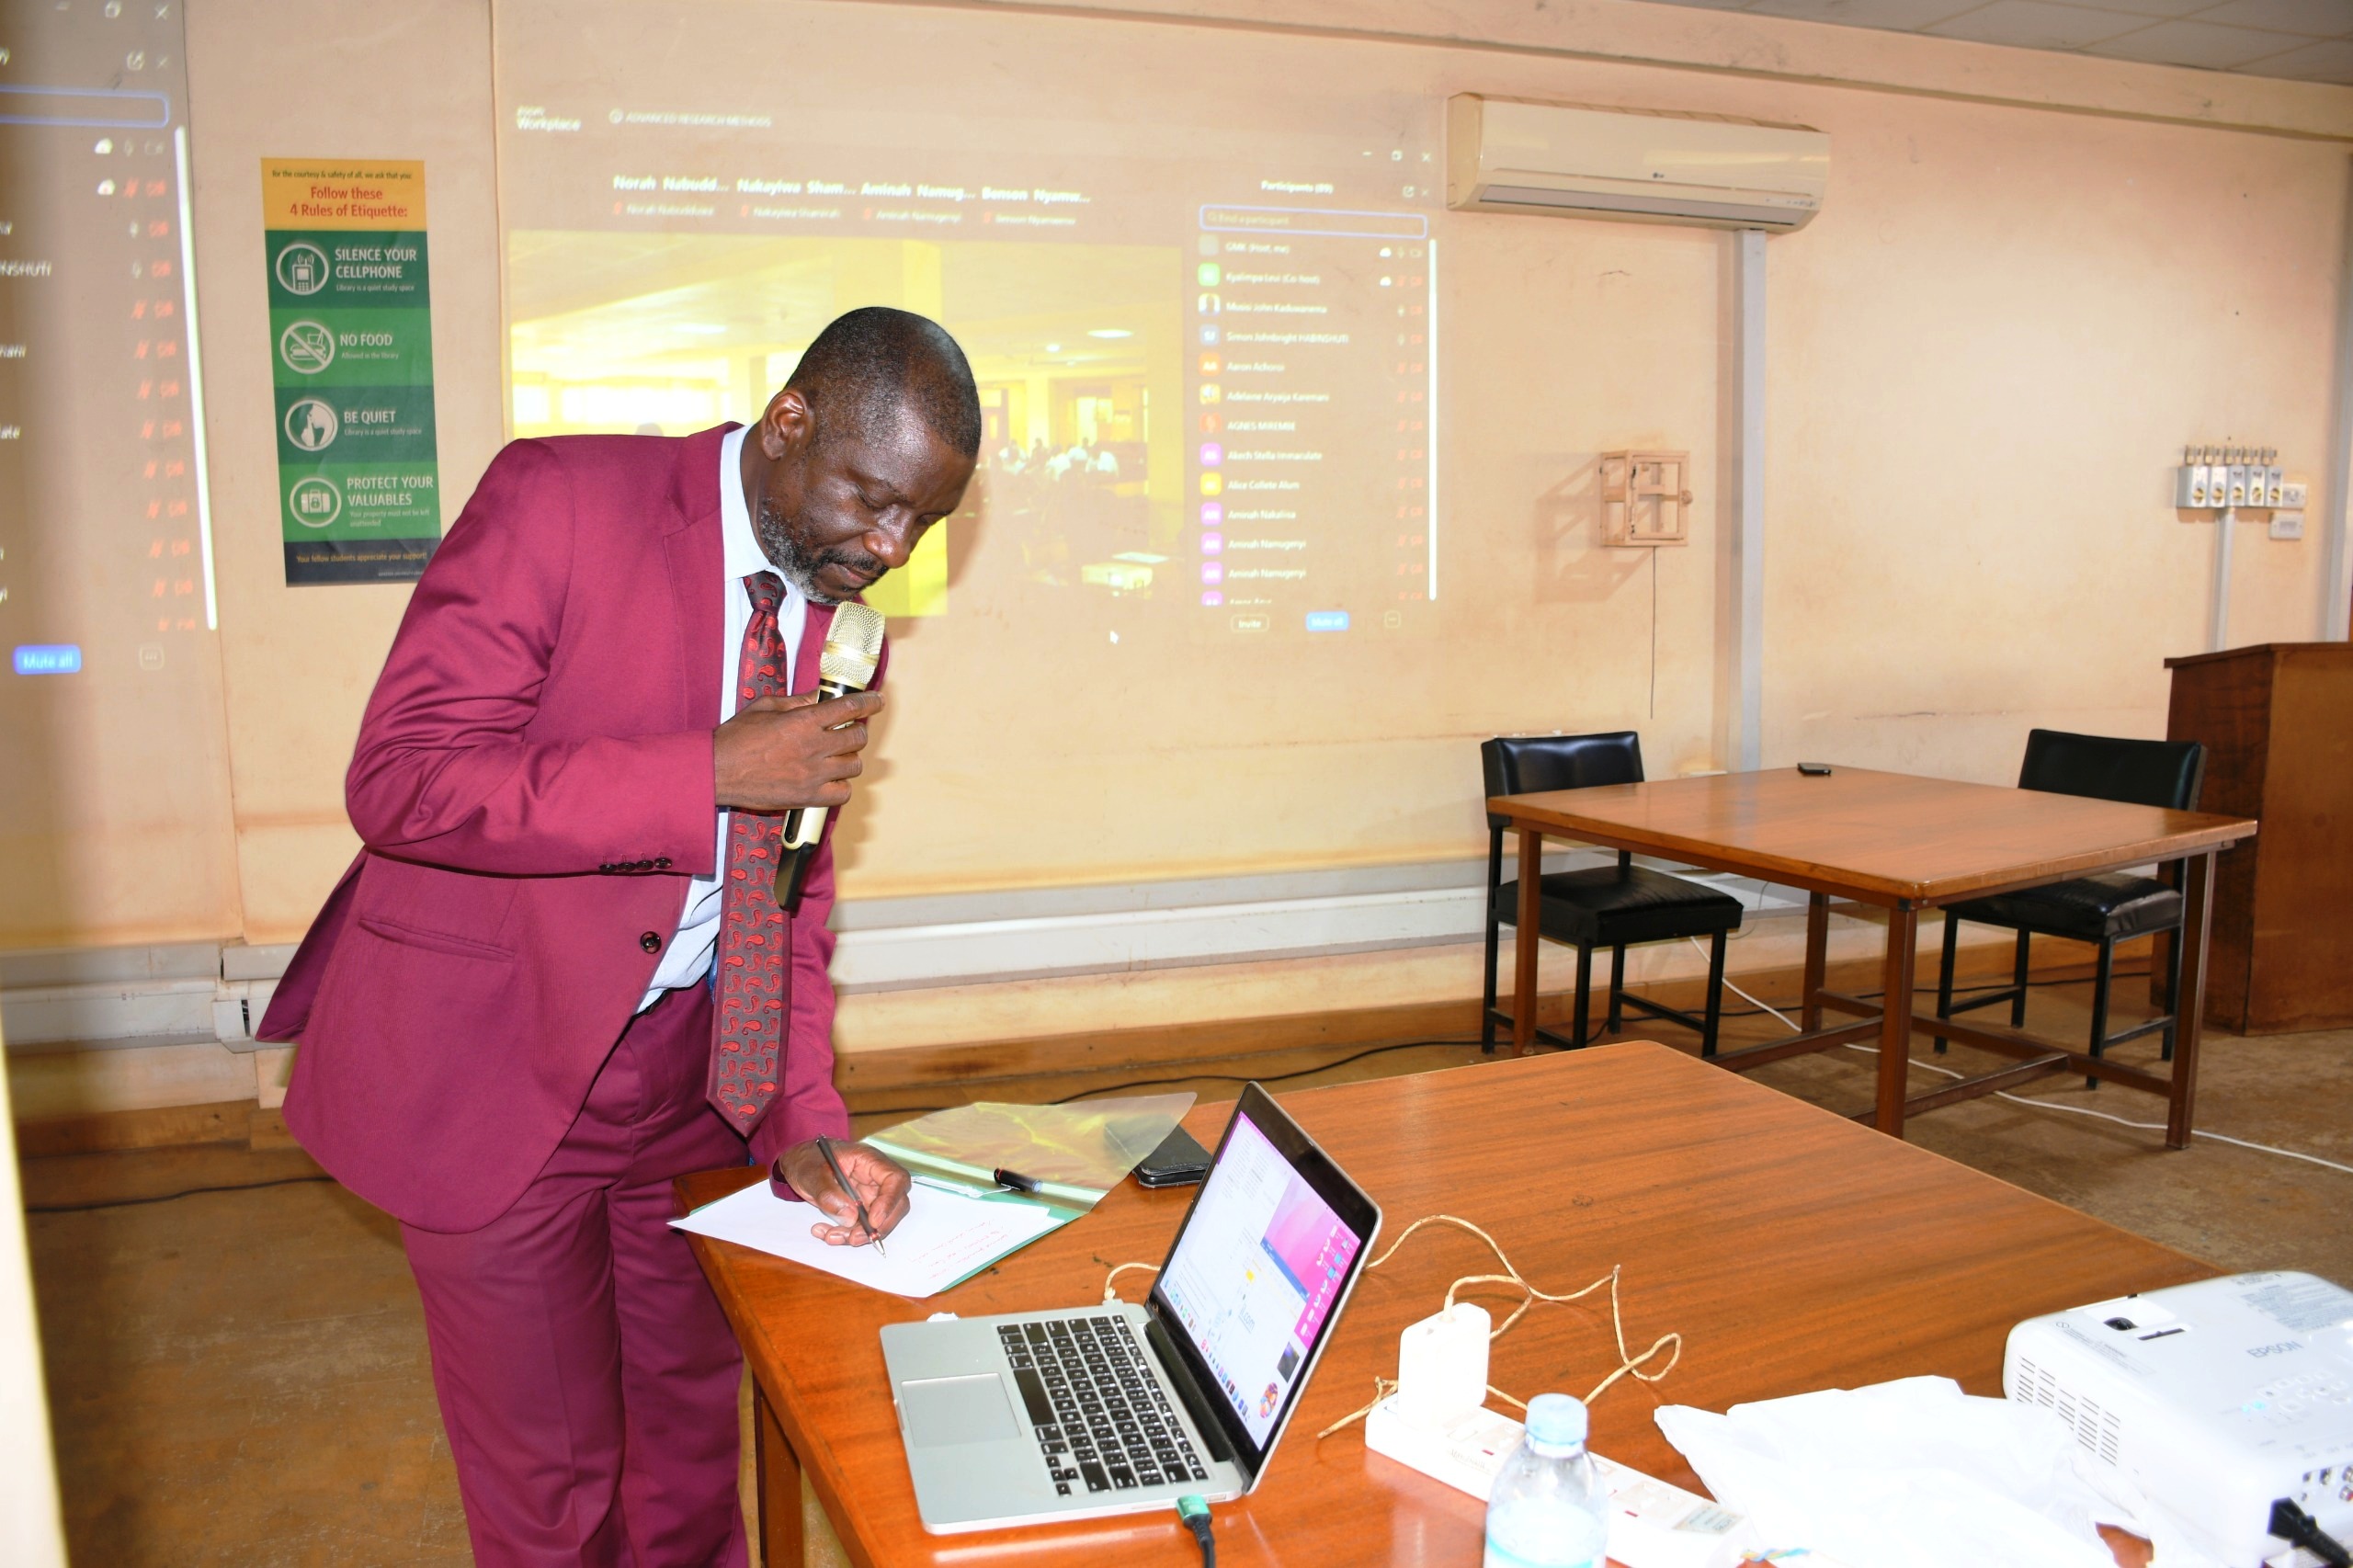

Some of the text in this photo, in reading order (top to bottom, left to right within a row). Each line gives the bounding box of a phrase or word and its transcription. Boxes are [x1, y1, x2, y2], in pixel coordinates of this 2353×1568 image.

[517, 117, 581, 131] Workplace
[311, 187, 382, 200] Follow these
[290, 204, 407, 220] 4 Rules of Etiquette:
[335, 248, 417, 262] SILENCE YOUR
[335, 266, 403, 278] CELLPHONE
[336, 284, 356, 292] Library
[340, 334, 392, 347] NO FOOD
[344, 411, 396, 425] BE QUIET
[347, 476, 434, 490] PROTECT YOUR
[347, 494, 413, 506] VALUABLES
[296, 555, 310, 563] Your
[312, 554, 329, 562] fellow
[331, 553, 357, 562] students
[23, 652, 74, 670] Mute all
[2245, 1340, 2304, 1358] EPSON
